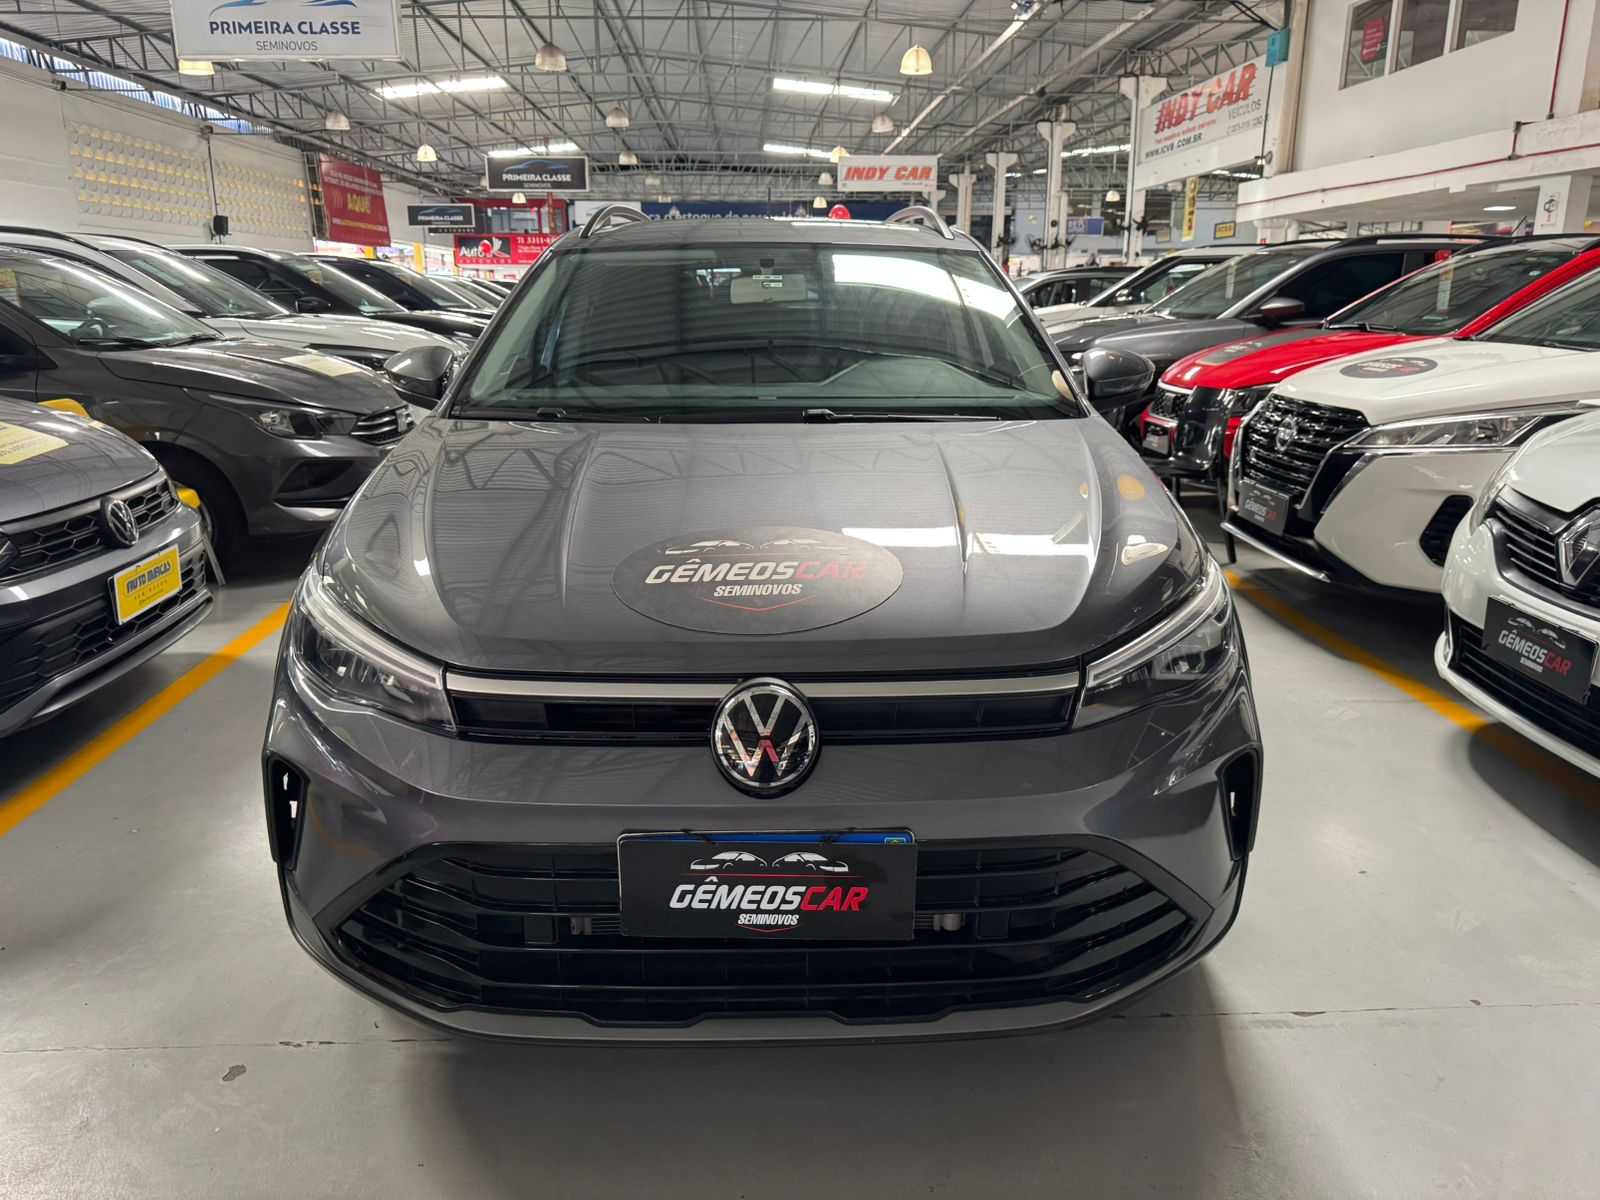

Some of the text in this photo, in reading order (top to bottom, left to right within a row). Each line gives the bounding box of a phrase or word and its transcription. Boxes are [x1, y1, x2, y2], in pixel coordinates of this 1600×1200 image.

[209, 21, 361, 35] PRIMEIRA CLASSE
[255, 40, 318, 51] SEMINOVOS
[1154, 87, 1206, 135] INDY
[1206, 63, 1258, 114] CAR
[502, 173, 572, 182] PRIMEIRA CLASSE
[844, 165, 933, 181] INDY CAR
[645, 558, 869, 584] GÊMEOSCAR
[713, 583, 803, 597] SEMINOVOS
[1498, 629, 1574, 676] GÊMEOSCAR
[668, 875, 869, 912] GÊMEOSCAR
[737, 913, 799, 925] SEMINOVOS
